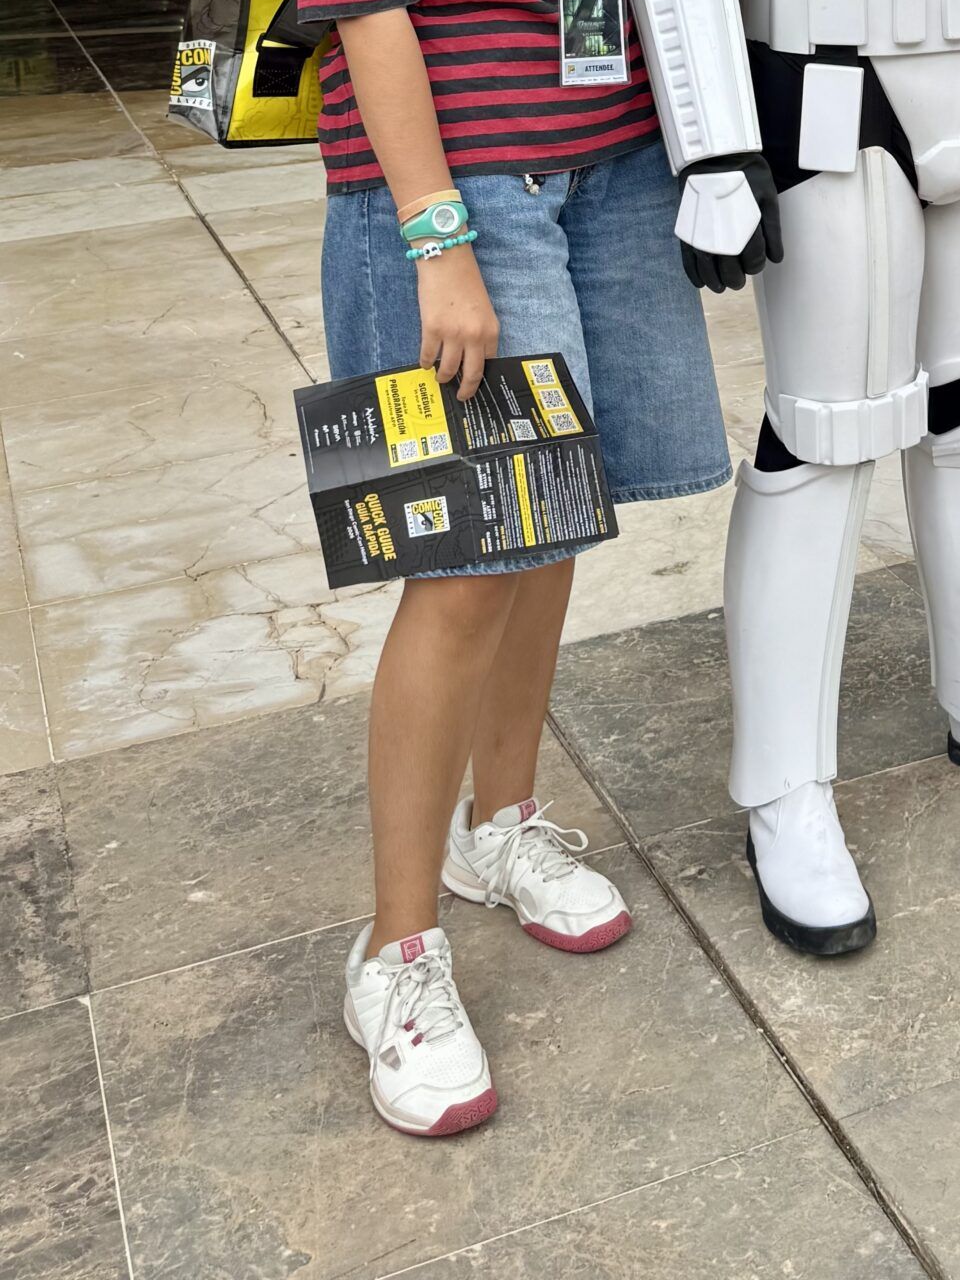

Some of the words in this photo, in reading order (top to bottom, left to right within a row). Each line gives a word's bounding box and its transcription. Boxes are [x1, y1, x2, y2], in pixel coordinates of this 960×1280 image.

[181, 49, 212, 66] CON
[584, 64, 614, 72] ATTENDEE
[390, 379, 406, 434] PROGRAMACIÓN
[419, 383, 432, 419] SCHEDULE
[356, 502, 371, 522] GUÍA
[412, 500, 442, 514] COMIC
[364, 494, 386, 526] QUICK
[377, 528, 396, 561] GUIDE
[434, 511, 444, 530] CON
[362, 524, 380, 557] RÁPIDA
